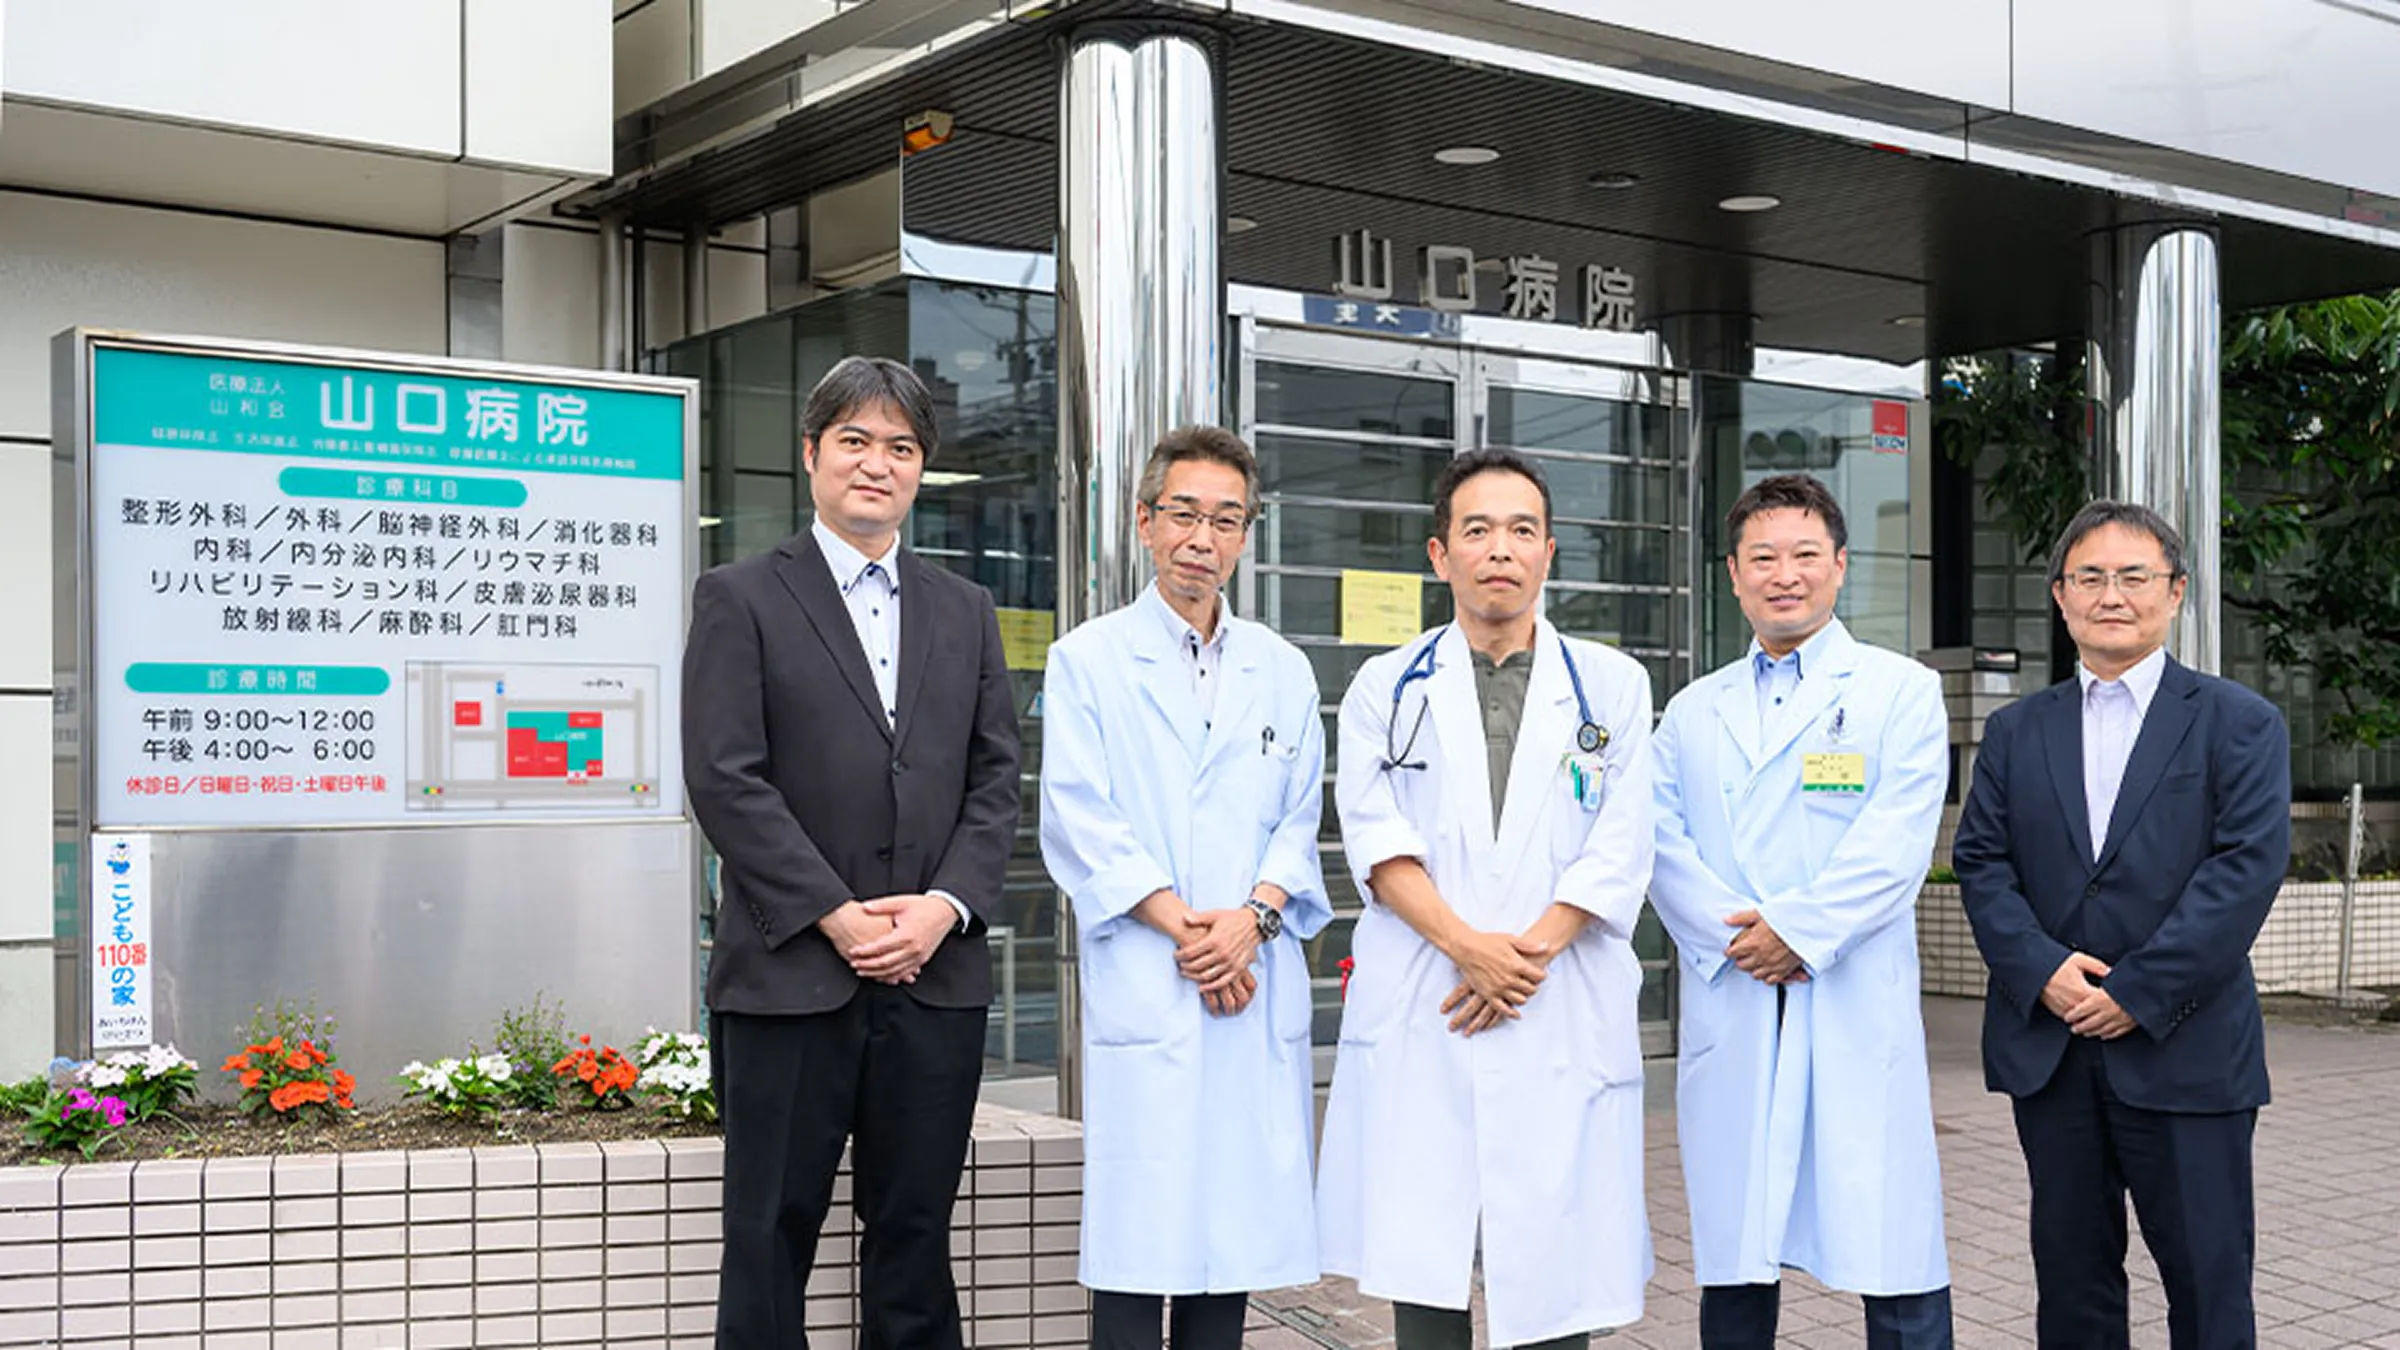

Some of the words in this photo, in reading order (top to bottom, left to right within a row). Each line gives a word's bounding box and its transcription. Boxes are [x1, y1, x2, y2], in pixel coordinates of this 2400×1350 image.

[1331, 228, 1637, 331] 山口病院
[321, 375, 589, 446] 山口病院
[356, 476, 458, 499] 診療科目
[121, 498, 658, 546] 整形外科／外科／脳神経外科／消化器科
[193, 538, 600, 575] 内科／内分泌内科／リウマチ科
[151, 570, 637, 608] リハビリテーション科／皮膚泌尿器科
[222, 606, 577, 638] 放射線科／麻酔科／肛門科
[207, 669, 318, 691] 診療時間
[143, 708, 194, 732] 午前
[143, 738, 194, 762] 午後
[313, 740, 376, 762] 6:00
